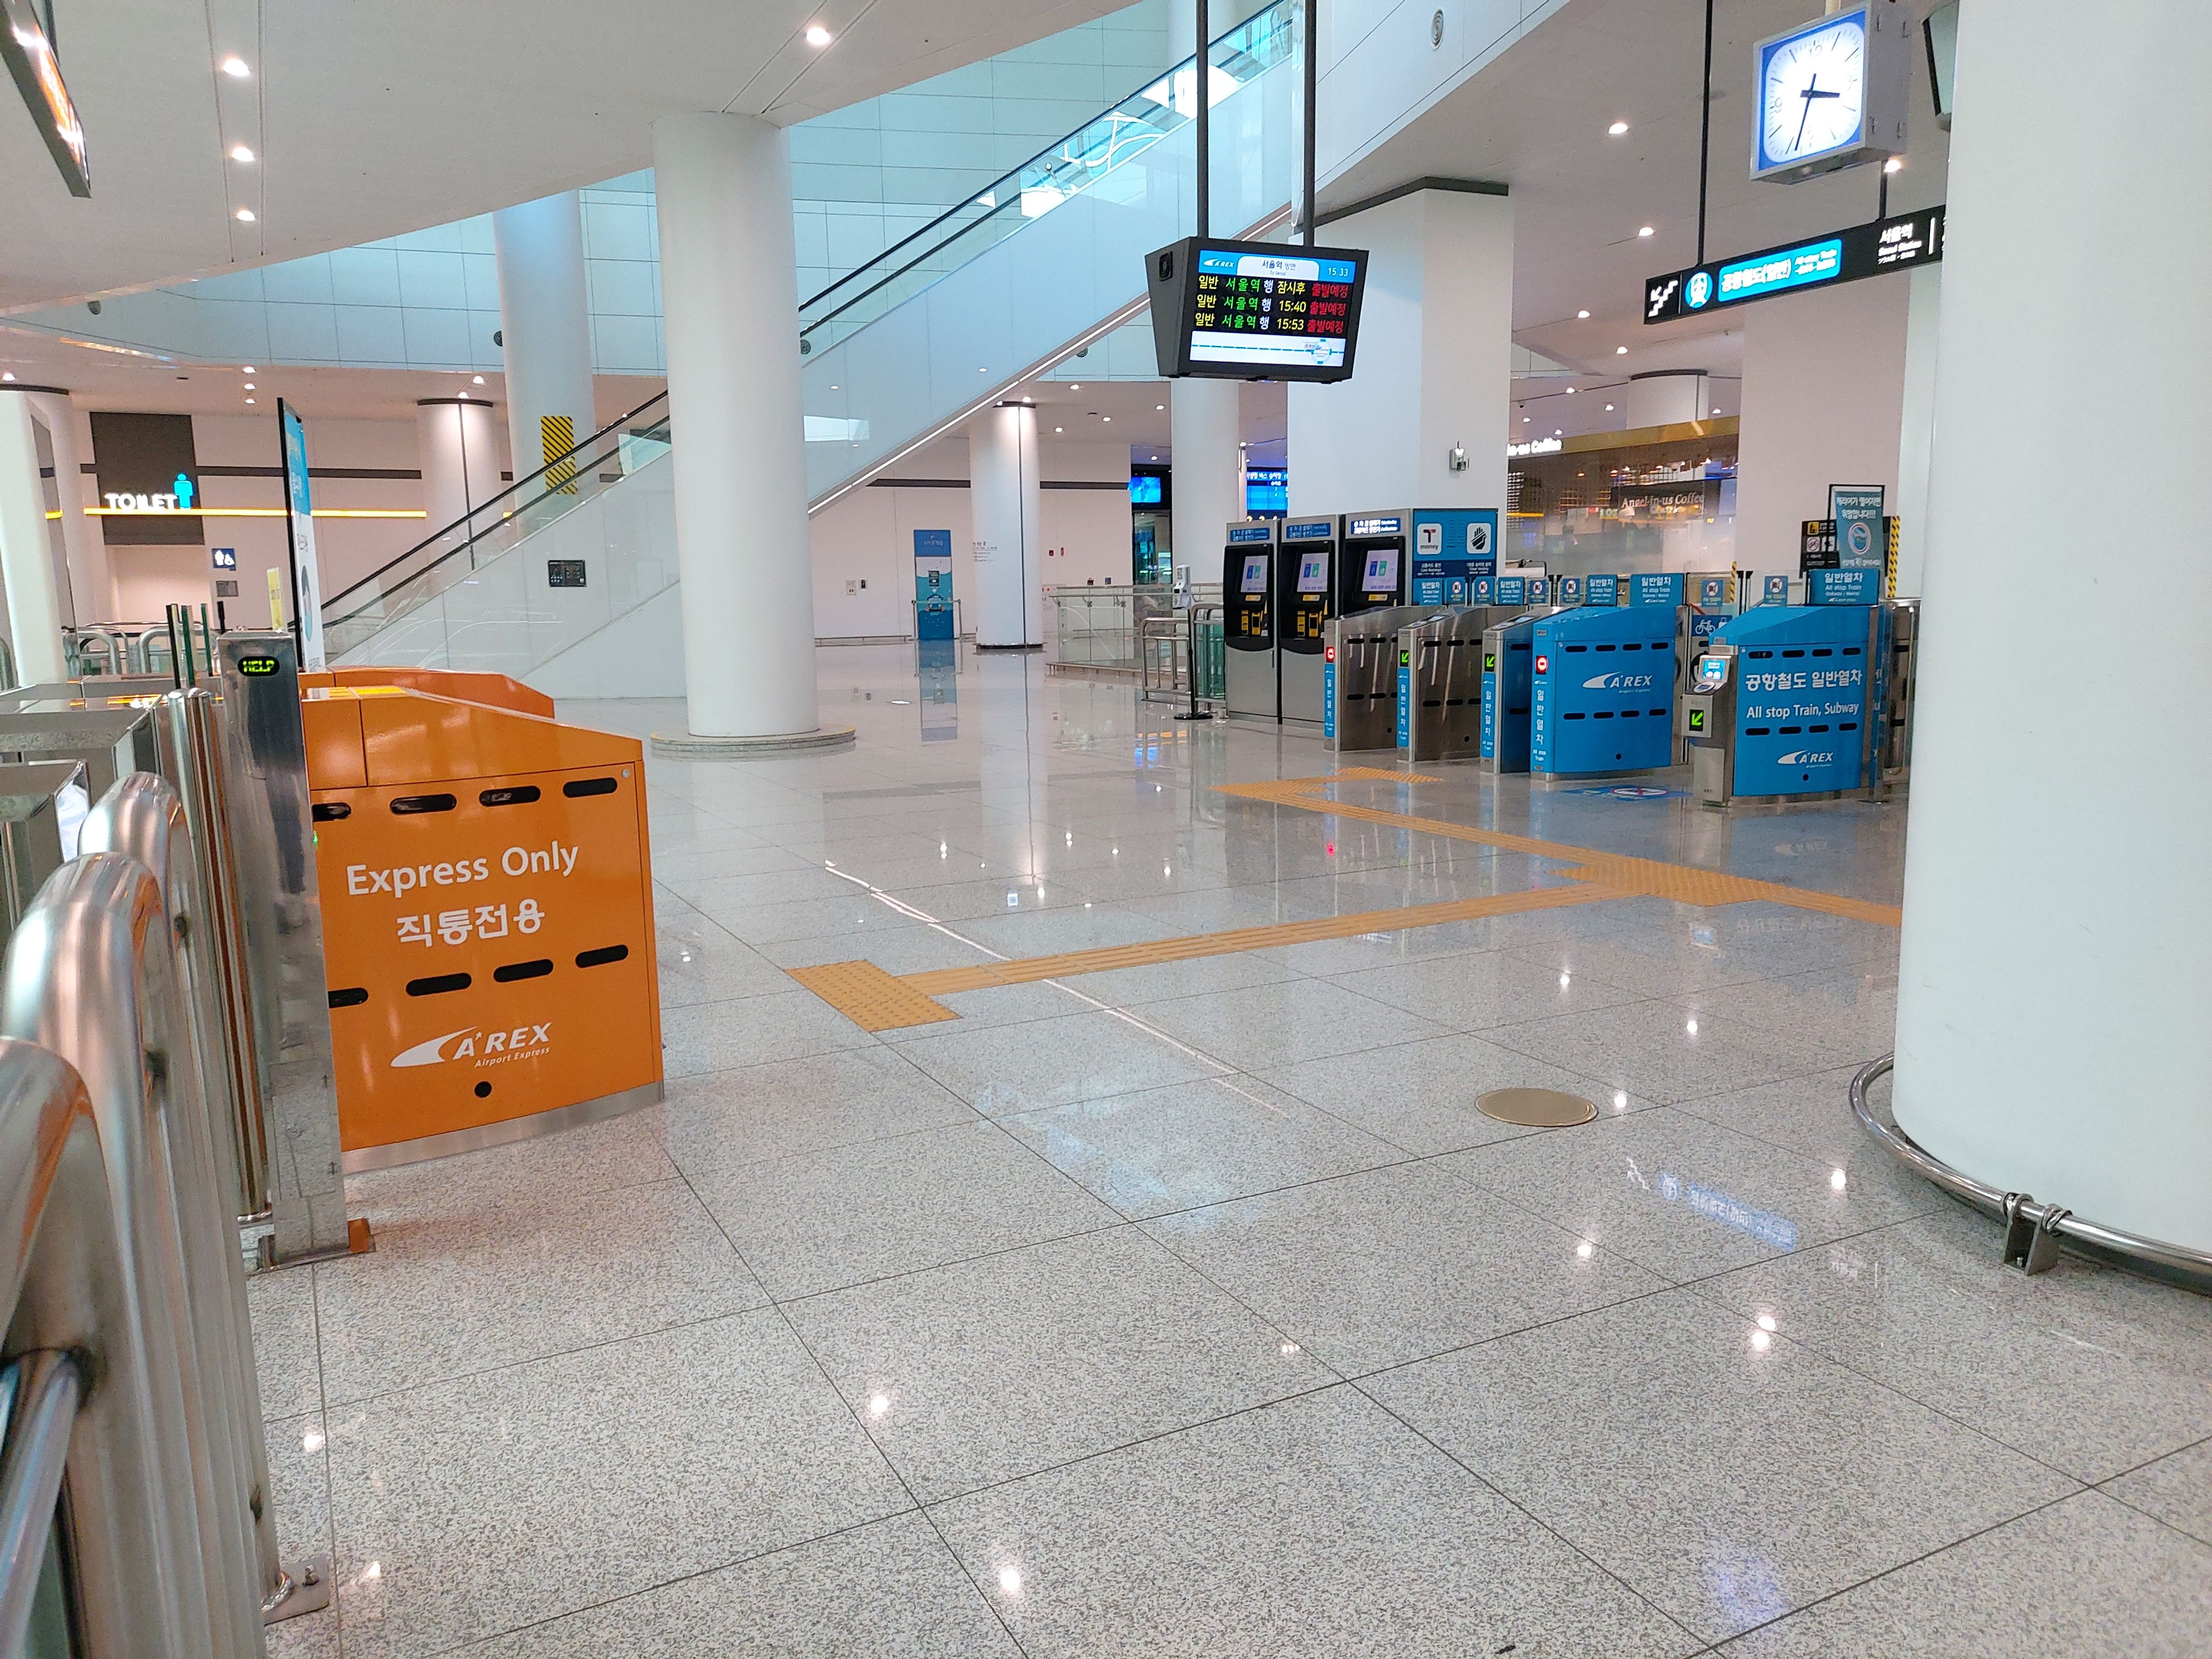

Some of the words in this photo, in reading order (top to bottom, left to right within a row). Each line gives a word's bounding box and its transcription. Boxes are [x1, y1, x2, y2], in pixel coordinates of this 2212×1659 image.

[1198, 275, 1219, 290] 일반
[1226, 276, 1261, 292] 서울역
[1263, 279, 1274, 294] 행
[1277, 280, 1306, 295] 잠시후
[1311, 283, 1350, 299] 출발예정
[1197, 294, 1217, 308] 일반
[1223, 296, 1259, 311] 서울역
[1262, 298, 1271, 312] 행
[1279, 300, 1307, 313] 15:40
[1310, 301, 1347, 317] 출발예정
[1195, 312, 1215, 327] 일반
[1221, 314, 1256, 329] 서울역
[1259, 315, 1269, 330] 행
[1277, 318, 1305, 330] 15:53
[1307, 319, 1344, 334] 출발예정
[104, 493, 178, 511] TOILET
[1621, 494, 1673, 508] Angel-in-us
[1675, 492, 1705, 504] Coffee
[1589, 579, 1613, 587] 일반열차
[1641, 577, 1671, 586] 일반열차
[1824, 572, 1863, 583] 일반열차
[242, 660, 275, 673] HELP
[1745, 672, 1807, 692] 공항철도
[1812, 669, 1863, 689] 일반열차
[1536, 689, 1544, 746] 일반열차
[1746, 706, 1762, 719] All
[1765, 706, 1790, 720] stop
[1793, 703, 1821, 718] Train,
[1824, 702, 1859, 716] Subway
[346, 858, 489, 898] Express
[501, 840, 579, 877] Only
[397, 898, 545, 947] 직통전용
[474, 1054, 512, 1068] Airport
[514, 1047, 550, 1060] Express
